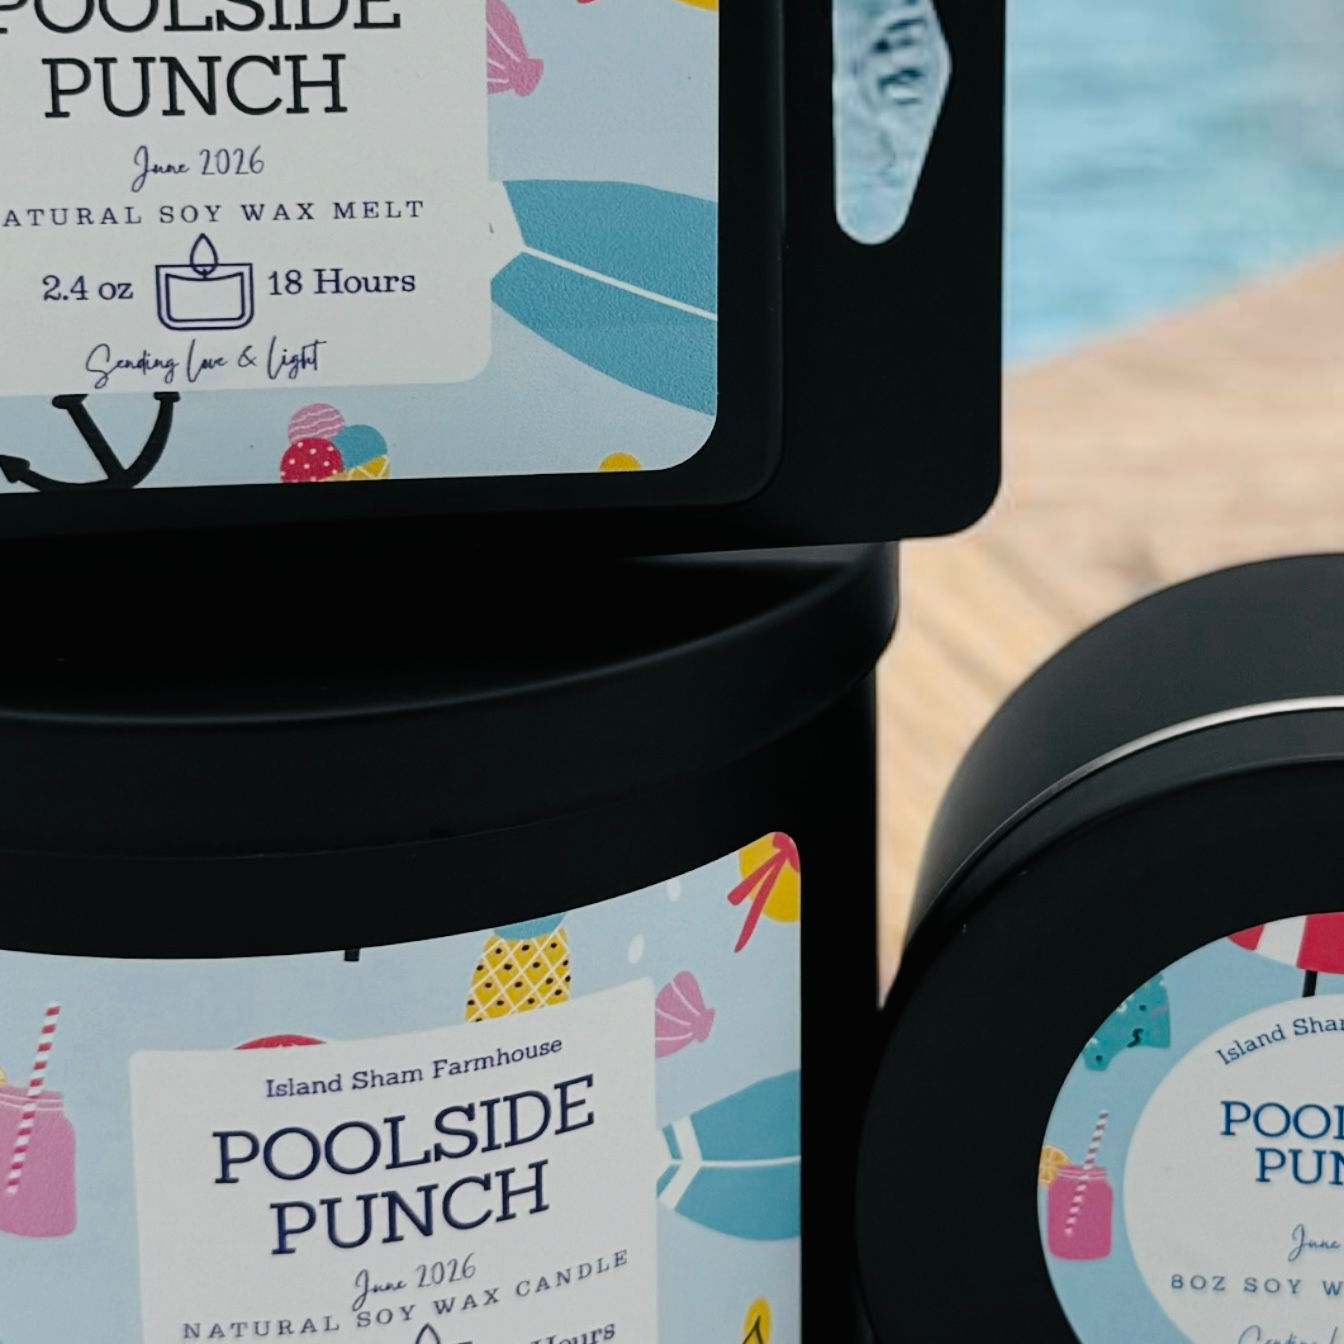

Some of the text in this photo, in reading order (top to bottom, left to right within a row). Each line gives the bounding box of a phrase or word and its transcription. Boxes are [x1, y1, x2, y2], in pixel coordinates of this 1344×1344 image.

[40, 52, 348, 119] PUNCH
[131, 145, 265, 193] June 2026
[158, 204, 222, 224] SOY
[239, 202, 315, 222] WAX
[332, 200, 424, 220] MELT
[41, 267, 416, 301] 2.4 oz 18 Hours
[84, 335, 327, 390] Sending Love & Light
[265, 1039, 563, 1099] Island Sham Farmhouse
[1216, 1024, 1287, 1065] Island
[211, 1074, 595, 1185] POOLSIDE
[268, 1158, 550, 1256] PUNCH
[1288, 1224, 1341, 1262] June
[183, 1249, 627, 1339] NATURAL SOY WAX CANDLE
[351, 1253, 476, 1313] June 2026
[1243, 1277, 1301, 1295] SOY
